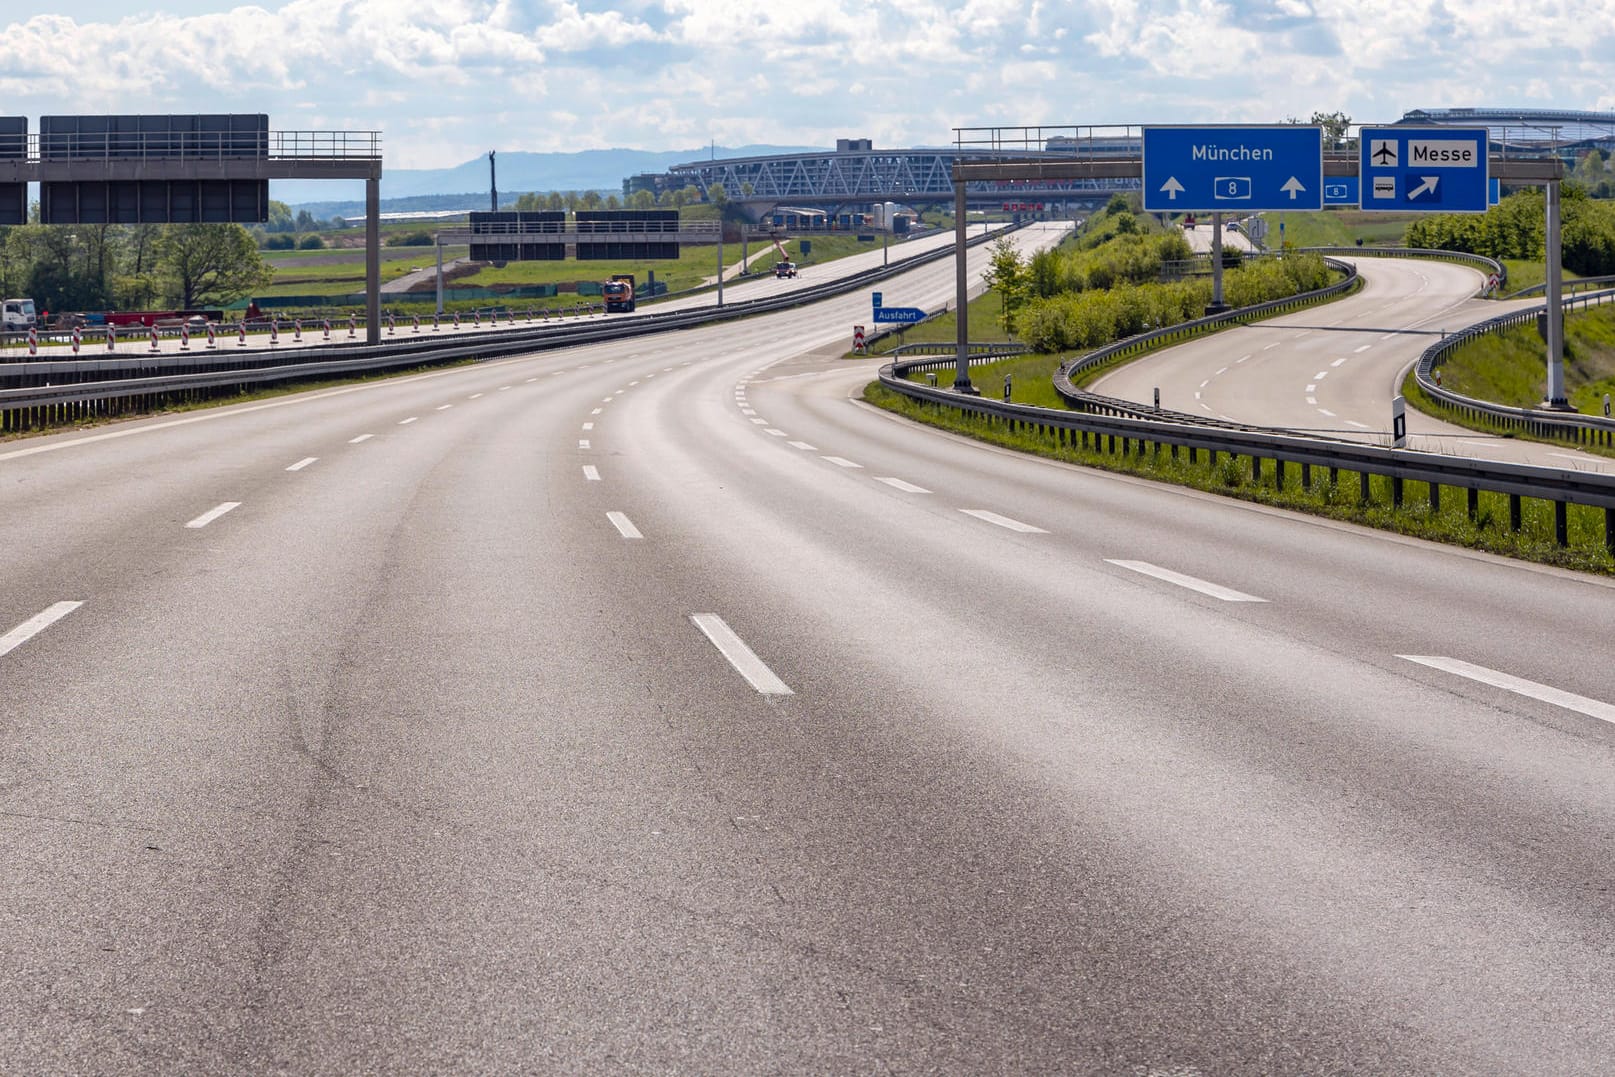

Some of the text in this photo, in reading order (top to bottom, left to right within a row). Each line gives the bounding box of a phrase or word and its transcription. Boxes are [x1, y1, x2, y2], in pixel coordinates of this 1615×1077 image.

[1192, 144, 1273, 160] München
[1413, 145, 1472, 162] Messe
[1228, 181, 1237, 195] 8
[878, 311, 916, 320] Ausfahrt
